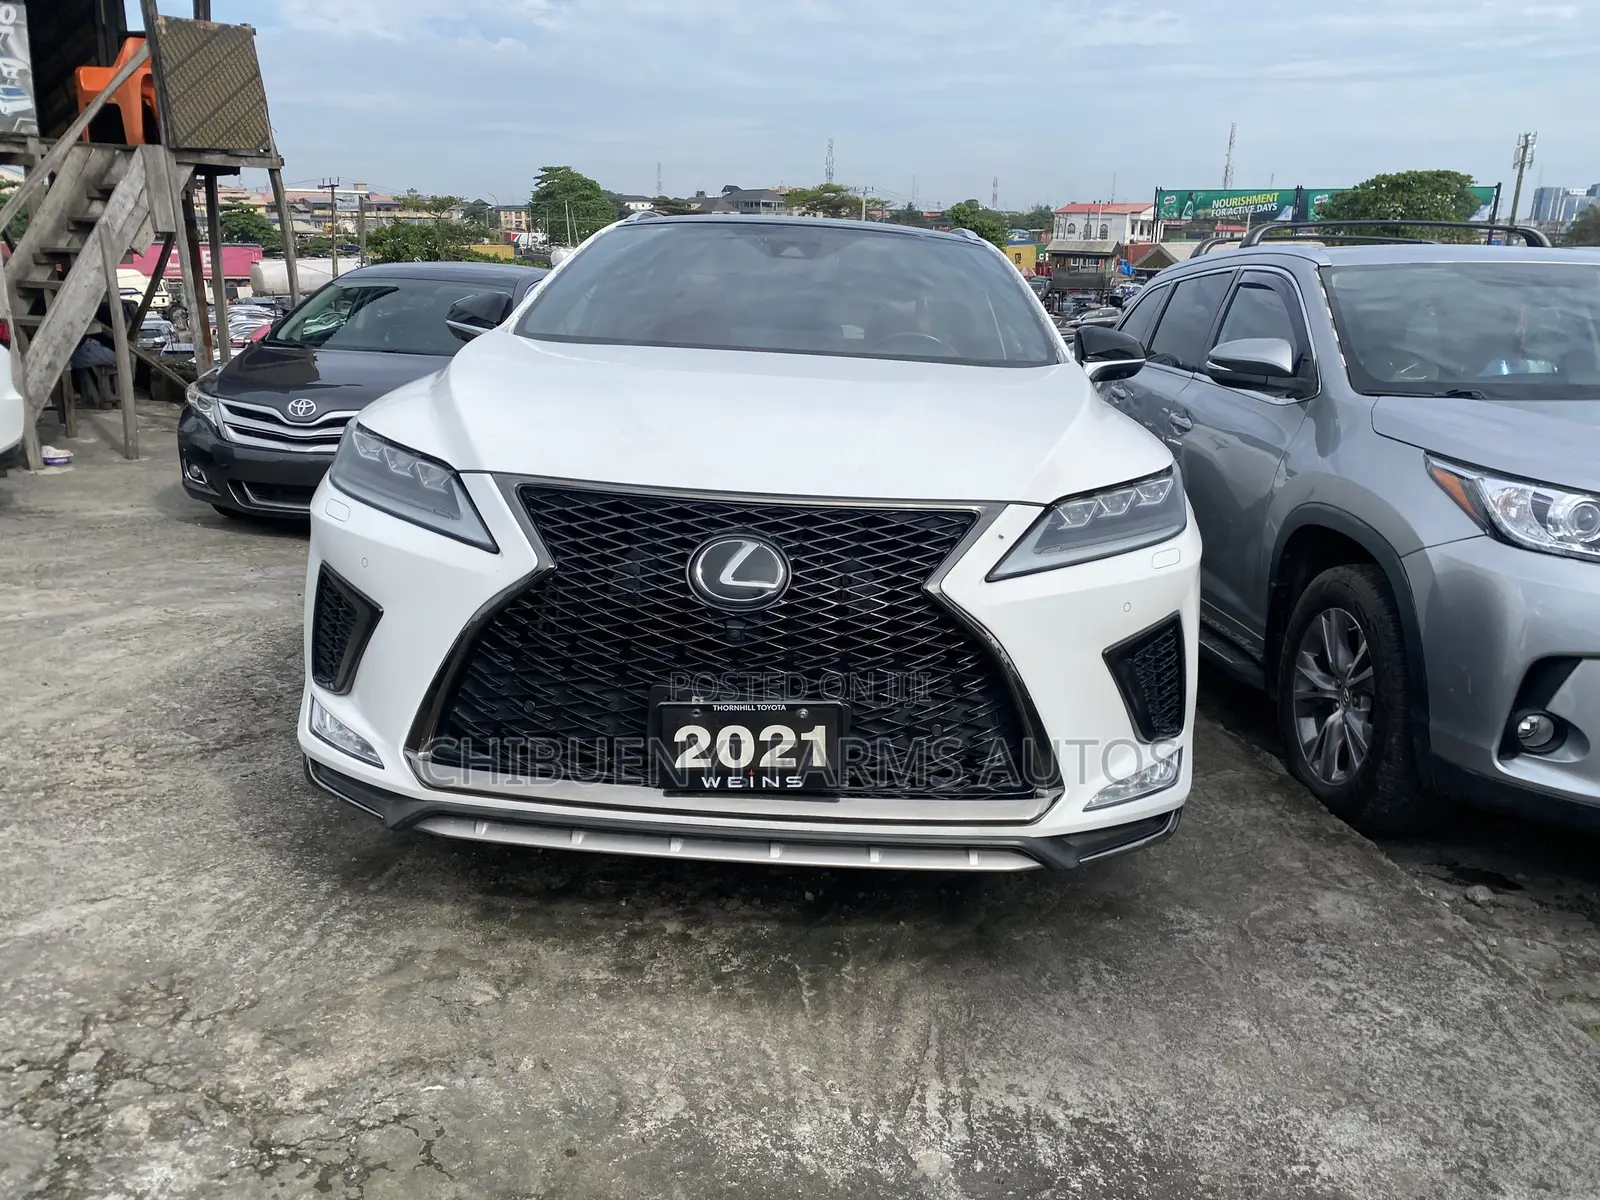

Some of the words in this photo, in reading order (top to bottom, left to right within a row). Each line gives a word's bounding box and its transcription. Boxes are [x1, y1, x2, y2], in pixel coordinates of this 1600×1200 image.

[1212, 192, 1279, 209] NOURISHMENT
[1211, 208, 1226, 218] FOR
[1227, 204, 1255, 215] ACTIVE
[1256, 202, 1278, 213] DAYS
[713, 704, 756, 712] THORNHILL
[756, 704, 787, 712] TOYOTA
[673, 724, 827, 769] 2021
